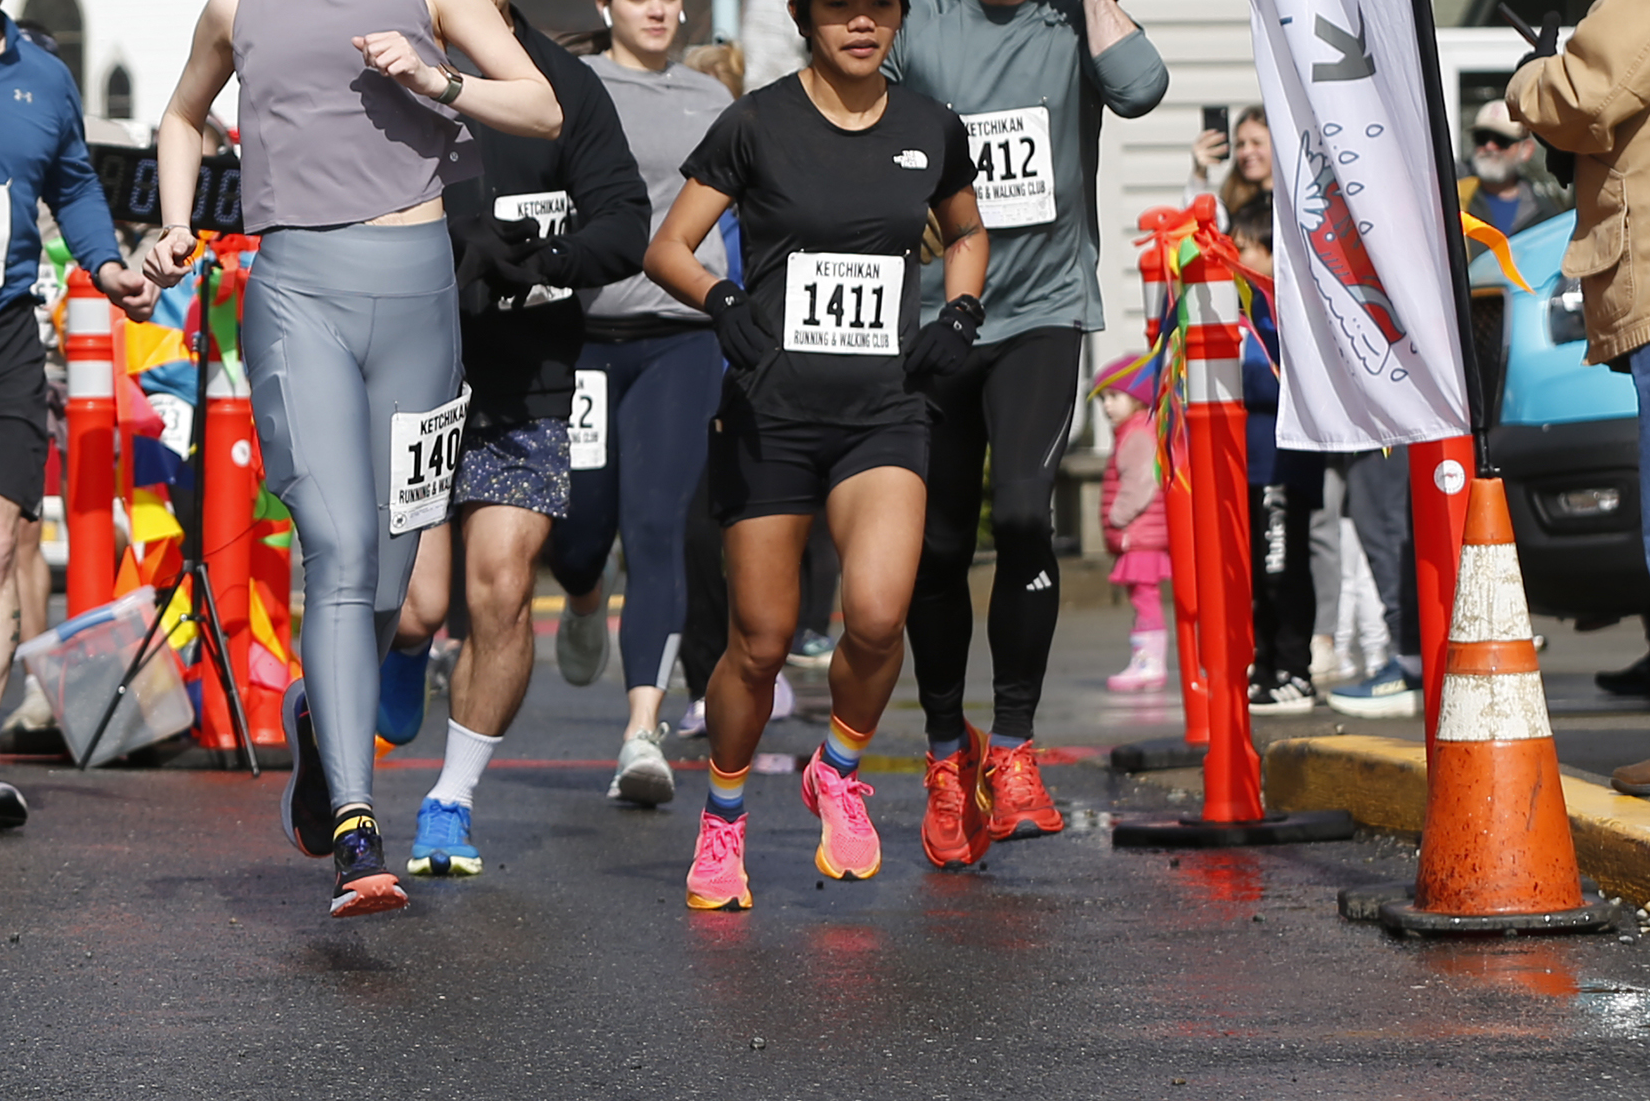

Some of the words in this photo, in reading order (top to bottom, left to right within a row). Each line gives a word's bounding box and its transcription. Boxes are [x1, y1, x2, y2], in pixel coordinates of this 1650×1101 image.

[965, 117, 1024, 137] KETCHIKAN
[977, 137, 1038, 181] 412
[993, 182, 1026, 199] WALKING
[1027, 180, 1045, 196] CLUB
[517, 198, 565, 217] KETCHIKAN
[816, 260, 880, 279] KETCHIKAN
[803, 282, 884, 328] 1411
[794, 330, 828, 346] RUNNING
[840, 332, 870, 347] WALKING
[873, 333, 889, 348] CLUB
[420, 403, 468, 435] KETCHIKAN
[407, 428, 460, 485] 140
